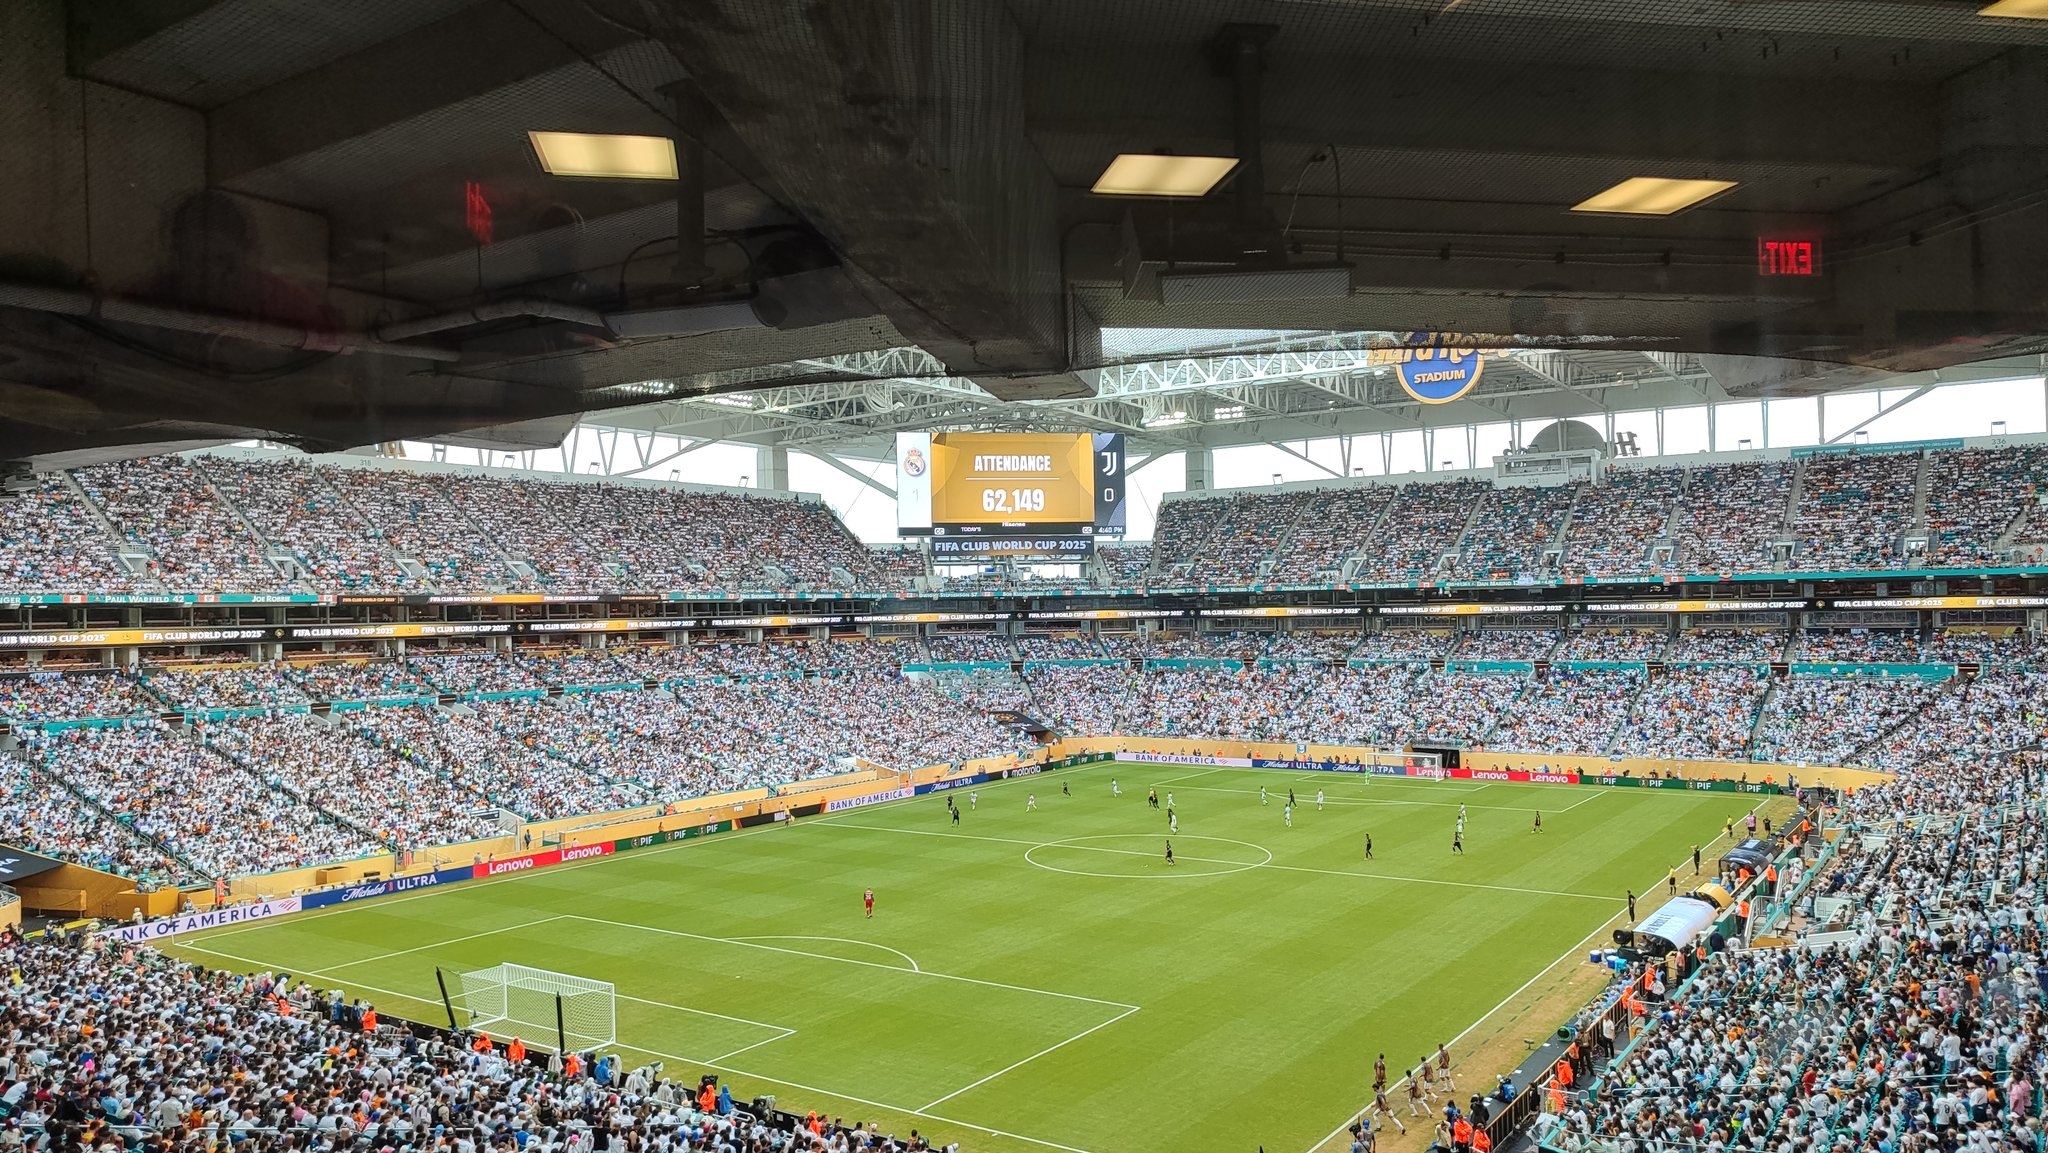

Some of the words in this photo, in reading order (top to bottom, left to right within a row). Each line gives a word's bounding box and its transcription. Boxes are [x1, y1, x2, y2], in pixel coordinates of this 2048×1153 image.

[1414, 369, 1466, 384] STADIUM
[974, 456, 1051, 472] ATTENDANCE
[1104, 488, 1115, 502] 0
[982, 488, 1045, 514] 62,149
[935, 542, 960, 552] FIFA
[961, 542, 990, 551] CLUB
[992, 541, 1029, 551] WORLD
[1032, 540, 1056, 550] CUP
[20, 635, 58, 644] WORLD
[59, 635, 78, 643] CUP
[144, 632, 163, 641] FIFA
[165, 632, 188, 640] CLUB
[189, 631, 221, 640] WORLD
[223, 630, 240, 639] CUP
[1136, 753, 1158, 762] BANK
[1174, 756, 1216, 764] AMERICA
[1012, 764, 1041, 776] motorola
[1296, 762, 1323, 770] ULTRA
[1472, 770, 1508, 780] Lenovo
[1530, 773, 1568, 783] Lenovo
[955, 777, 973, 787] ULTRA
[1603, 777, 1616, 785] PIF
[1649, 779, 1663, 787] PIF
[1696, 782, 1711, 790] PIF
[1746, 785, 1762, 793] PIF
[830, 799, 854, 811] BANK
[856, 796, 867, 806] OF
[868, 790, 903, 804] AMERICA
[706, 824, 718, 833] PIF
[674, 830, 686, 840] PIF
[640, 836, 653, 846] PIF
[561, 845, 602, 862] Lenovo
[489, 856, 534, 875] Lenovo
[342, 882, 386, 902] Michelob
[397, 874, 438, 891] ULTRA
[156, 920, 180, 935] OF
[187, 904, 272, 930] AMERICA
